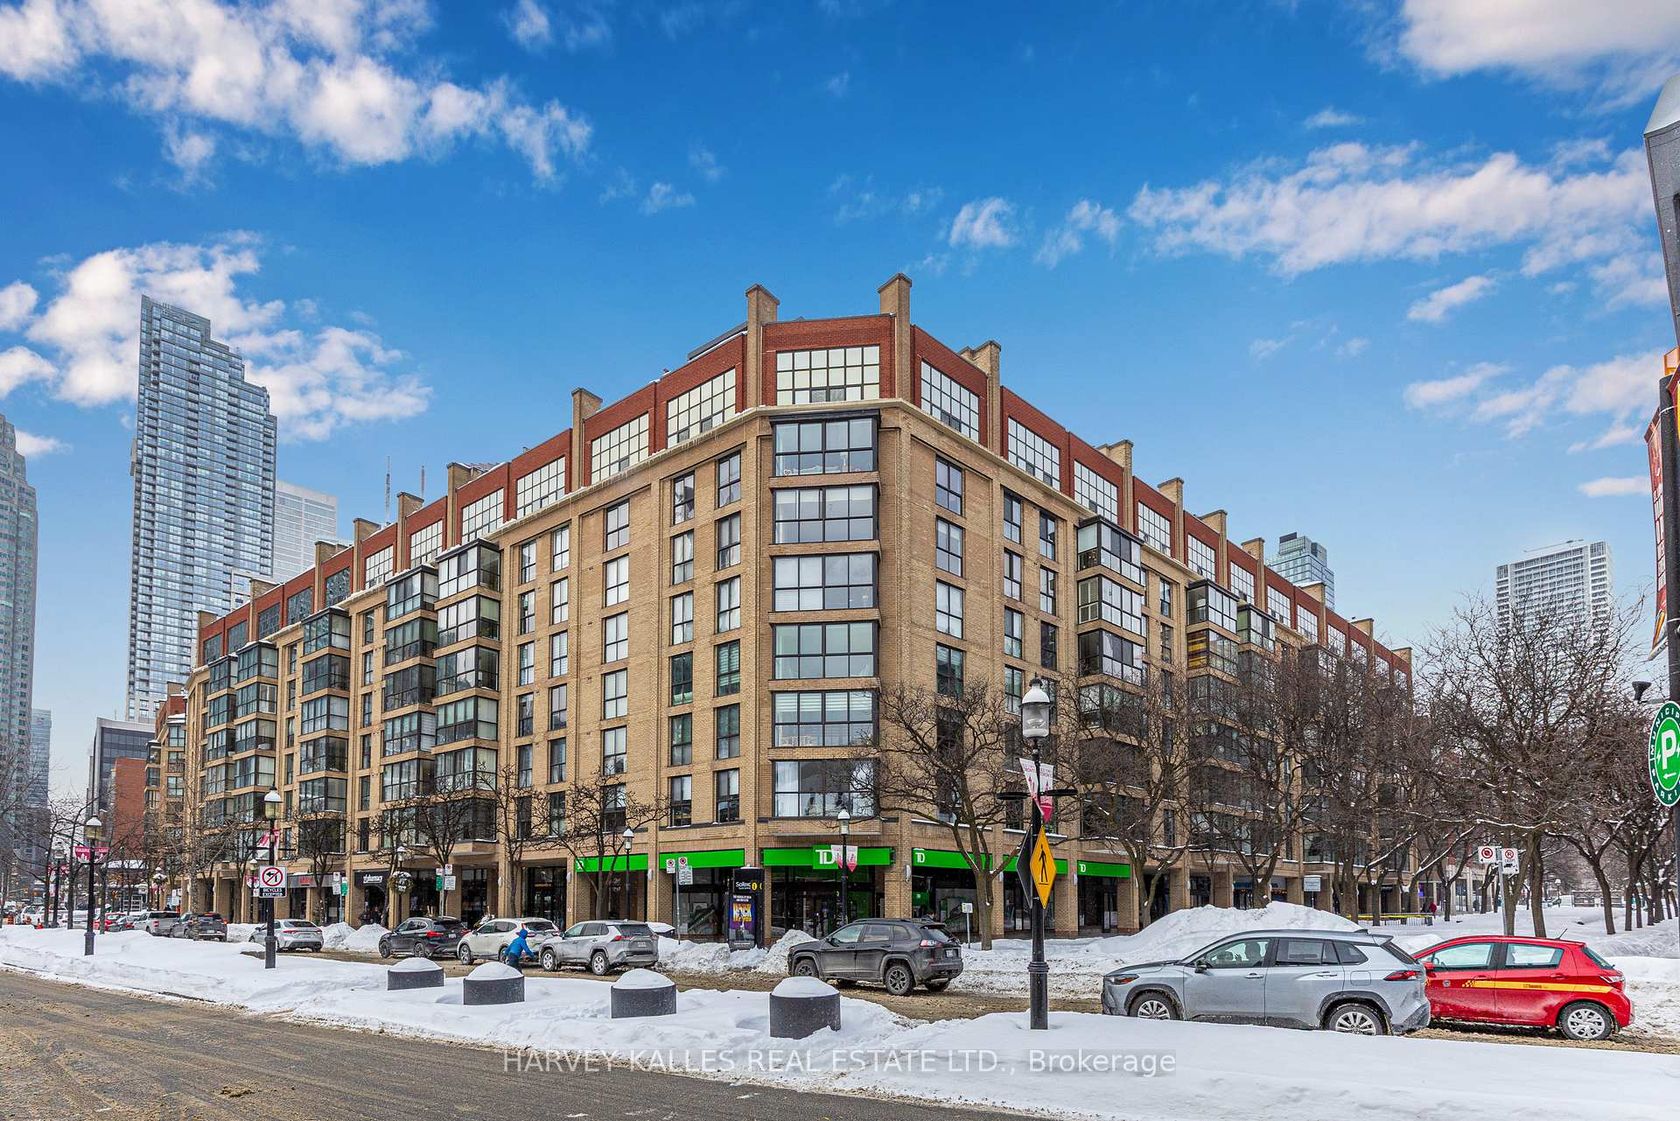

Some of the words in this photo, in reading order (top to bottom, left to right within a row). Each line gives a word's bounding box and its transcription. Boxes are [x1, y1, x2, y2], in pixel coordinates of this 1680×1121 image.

[1661, 729, 1677, 770] P
[815, 849, 839, 865] TD
[915, 852, 926, 863] TD
